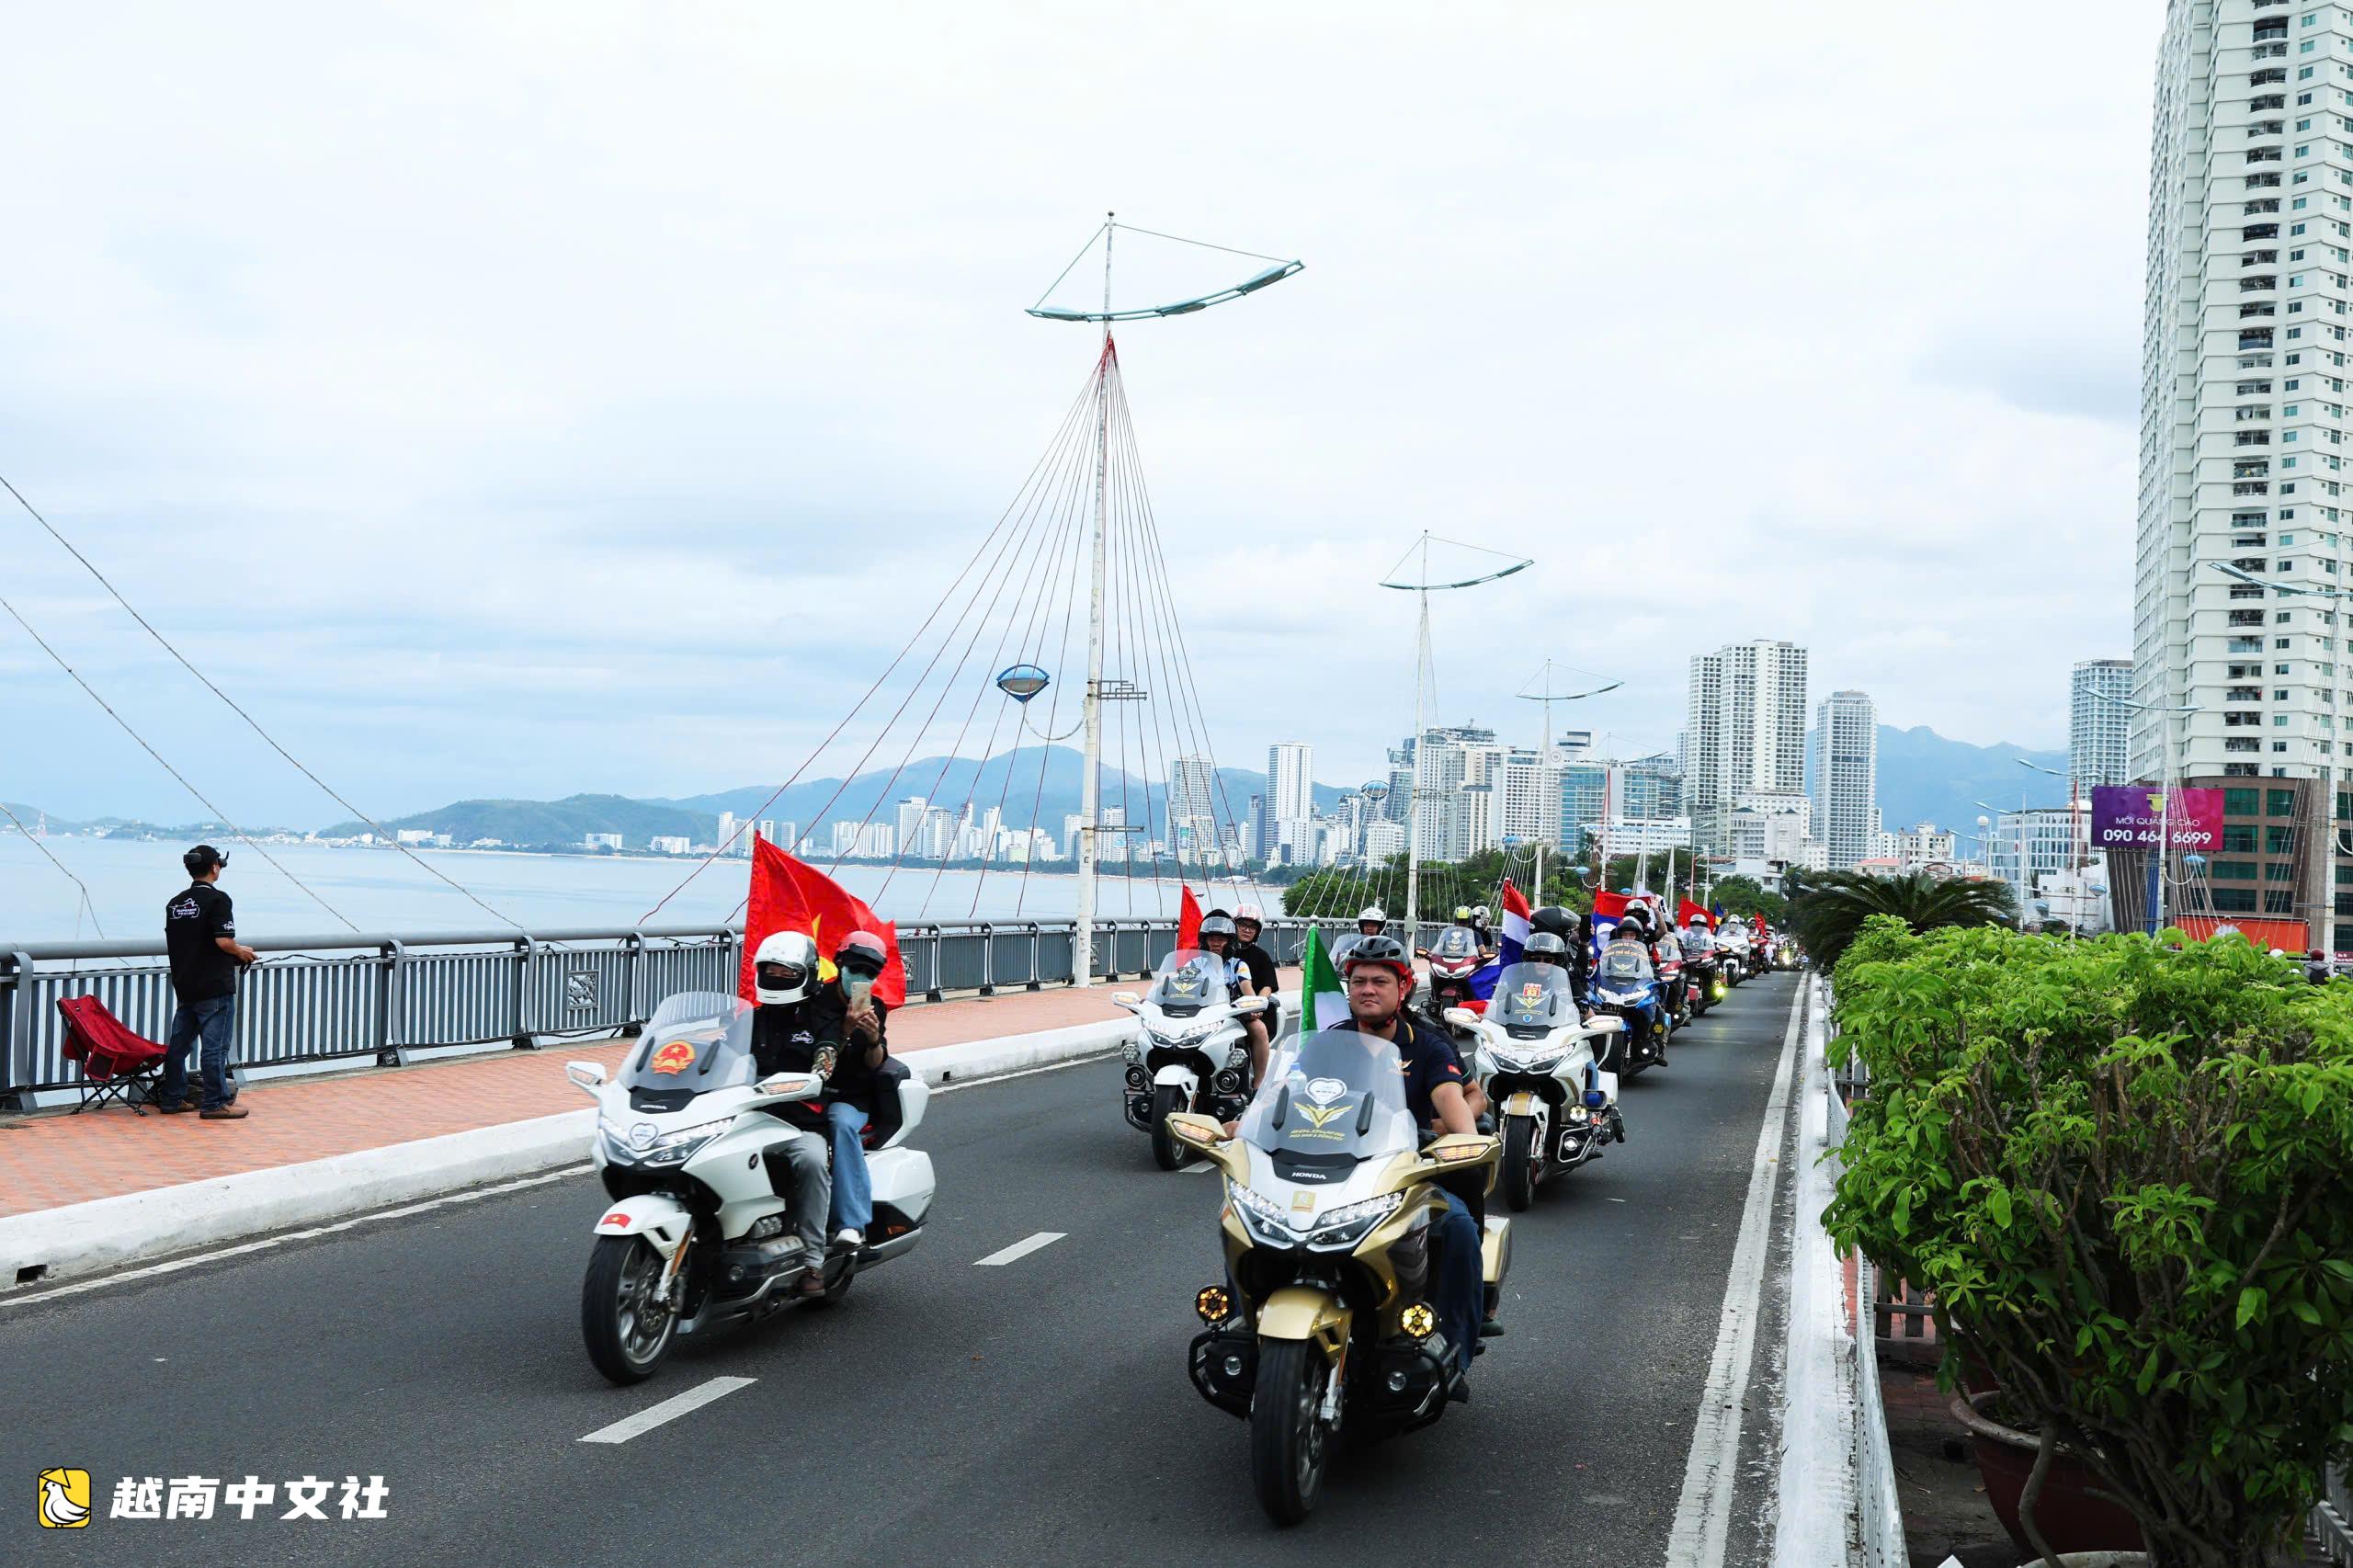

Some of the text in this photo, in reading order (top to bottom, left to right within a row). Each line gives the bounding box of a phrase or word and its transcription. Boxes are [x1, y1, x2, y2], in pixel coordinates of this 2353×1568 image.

[2136, 816, 2174, 826] QUẢG
[2103, 829, 2132, 842] 090
[2172, 832, 2211, 844] 6699
[1291, 1172, 1327, 1180] HONDA
